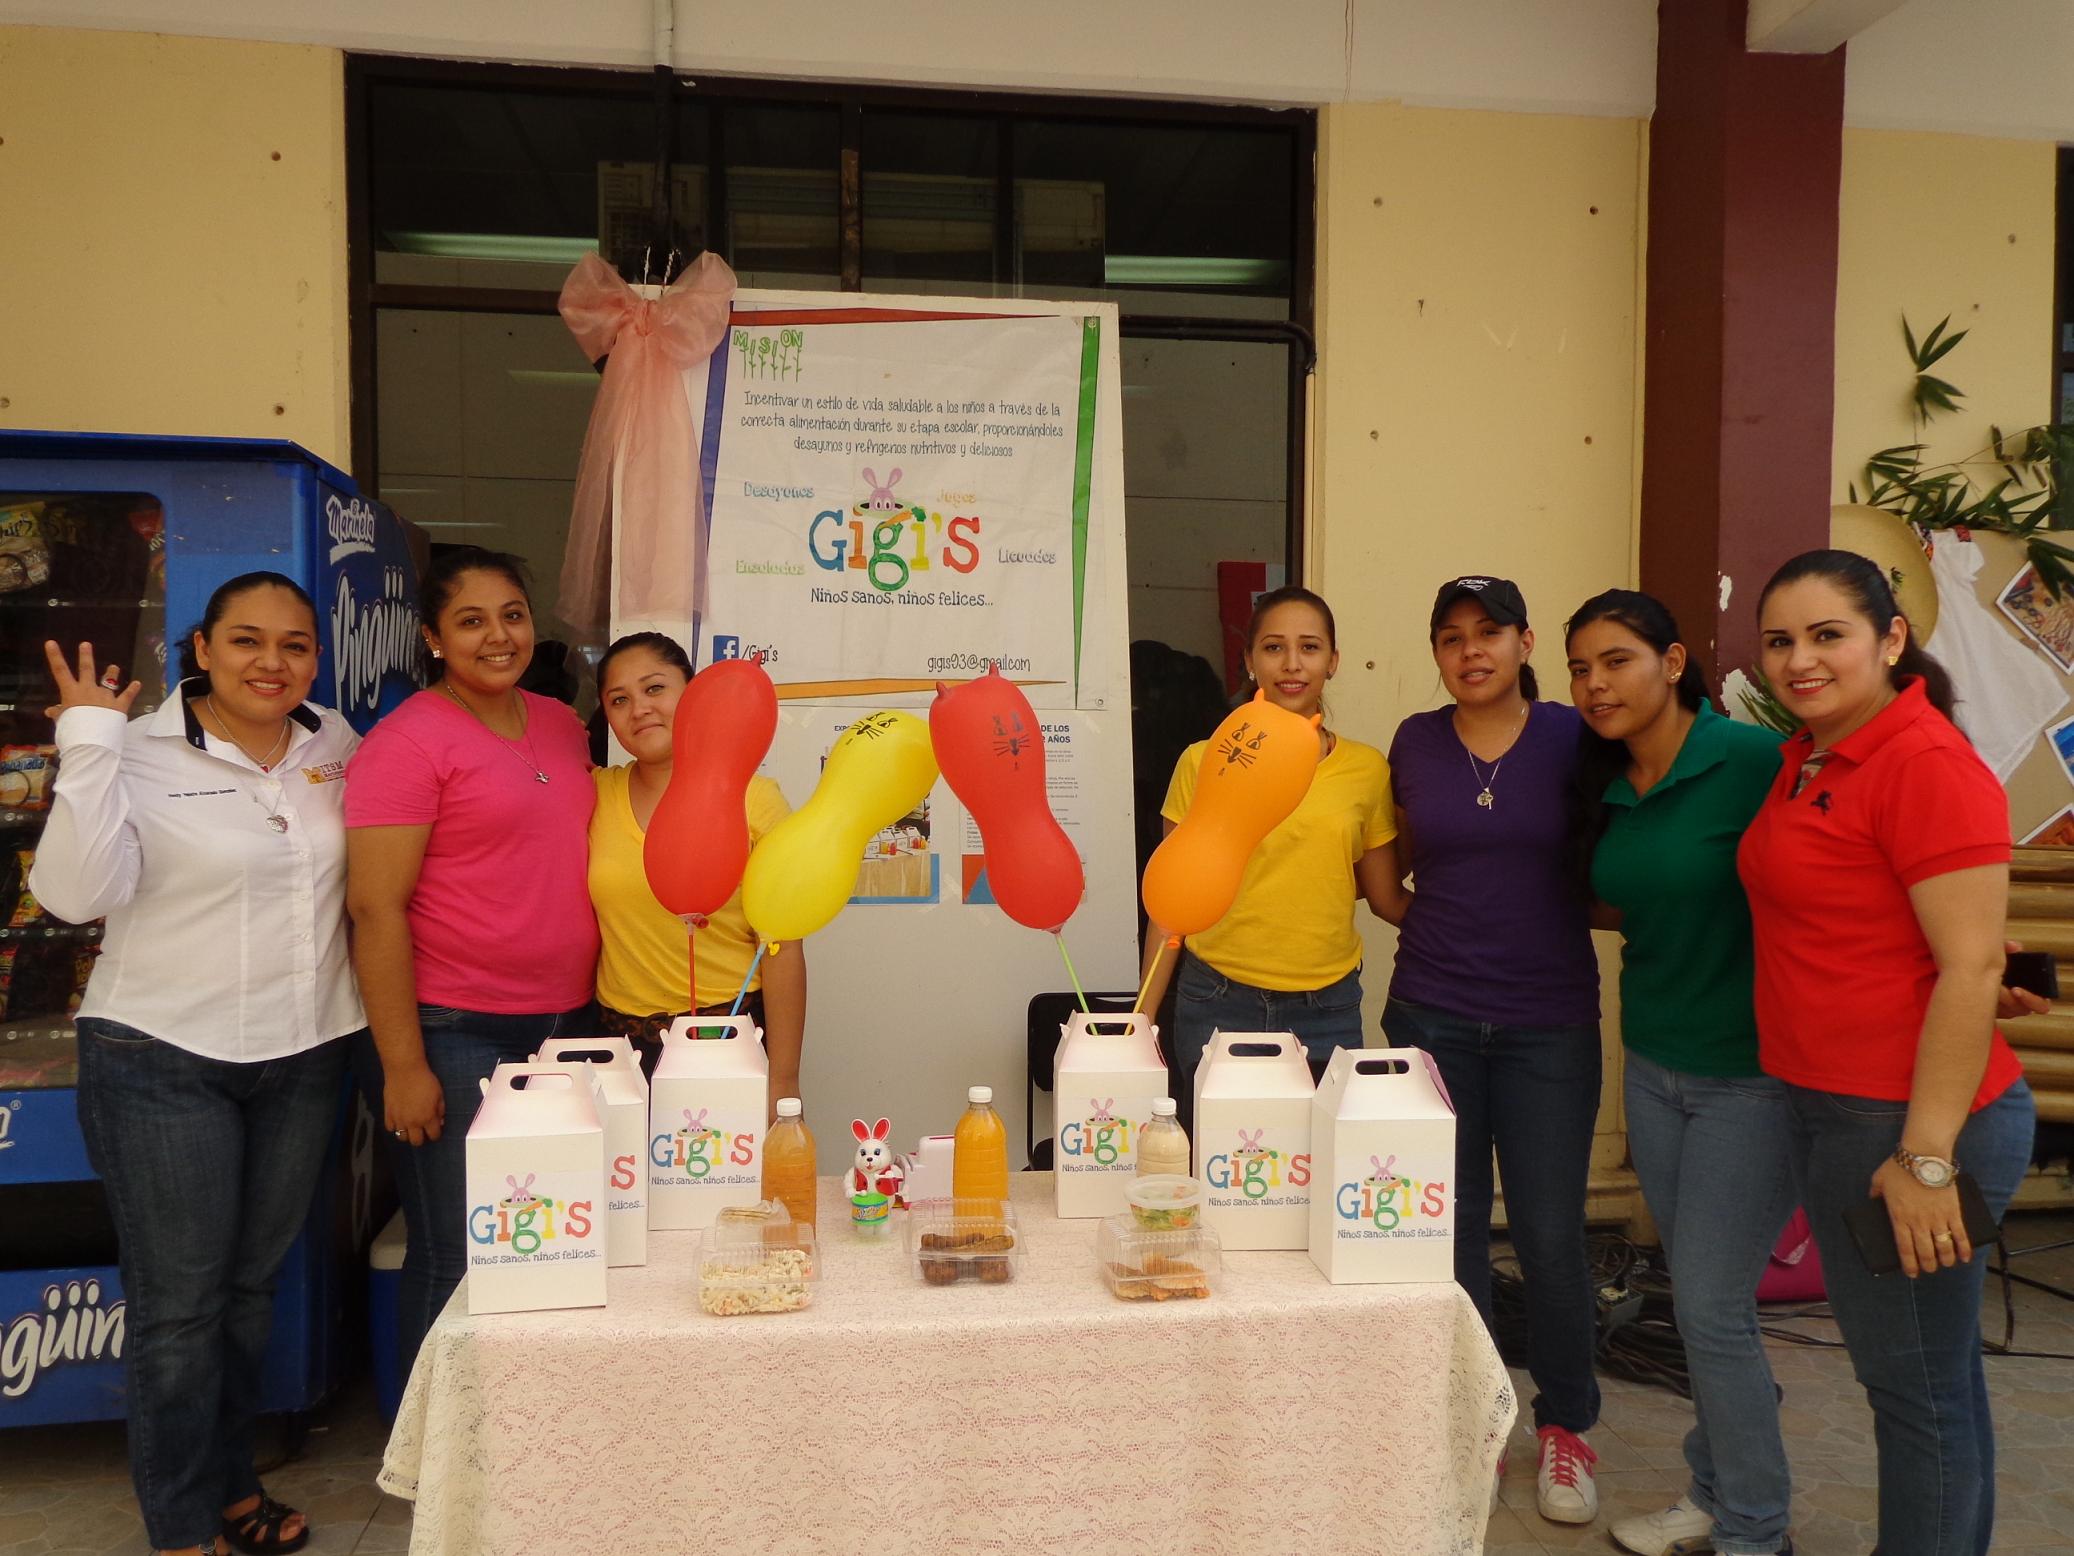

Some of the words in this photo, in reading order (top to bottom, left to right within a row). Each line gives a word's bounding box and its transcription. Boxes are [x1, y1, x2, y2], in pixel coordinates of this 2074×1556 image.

[743, 390, 799, 408] Incentivar
[801, 398, 813, 409] un
[816, 395, 843, 410] estilo
[845, 396, 859, 410] de
[862, 397, 884, 412] vida
[888, 397, 934, 413] saludable
[936, 402, 943, 414] a
[946, 399, 959, 414] los
[962, 400, 985, 414] niños
[988, 402, 995, 414] a
[1035, 402, 1049, 416] de
[1051, 402, 1061, 417] la
[740, 412, 785, 427] correcta
[789, 414, 851, 432] alimentación
[853, 418, 893, 433] durante
[896, 422, 907, 433] su
[910, 419, 940, 436] etapa
[793, 436, 843, 454] desayunos
[845, 442, 852, 455] y
[855, 438, 907, 457] refrigerios
[910, 441, 957, 455] nutritivos
[960, 445, 967, 458] y
[969, 441, 1013, 457] deliciosos
[743, 481, 814, 502] Desayunos
[326, 494, 375, 545] Marinela
[998, 548, 1057, 565] Licuados
[851, 590, 894, 605] sanos,
[1040, 724, 1052, 733] DE
[1053, 724, 1070, 733] LOS
[1047, 734, 1071, 744] AÑOS
[1060, 1120, 1149, 1165] Gigi'
